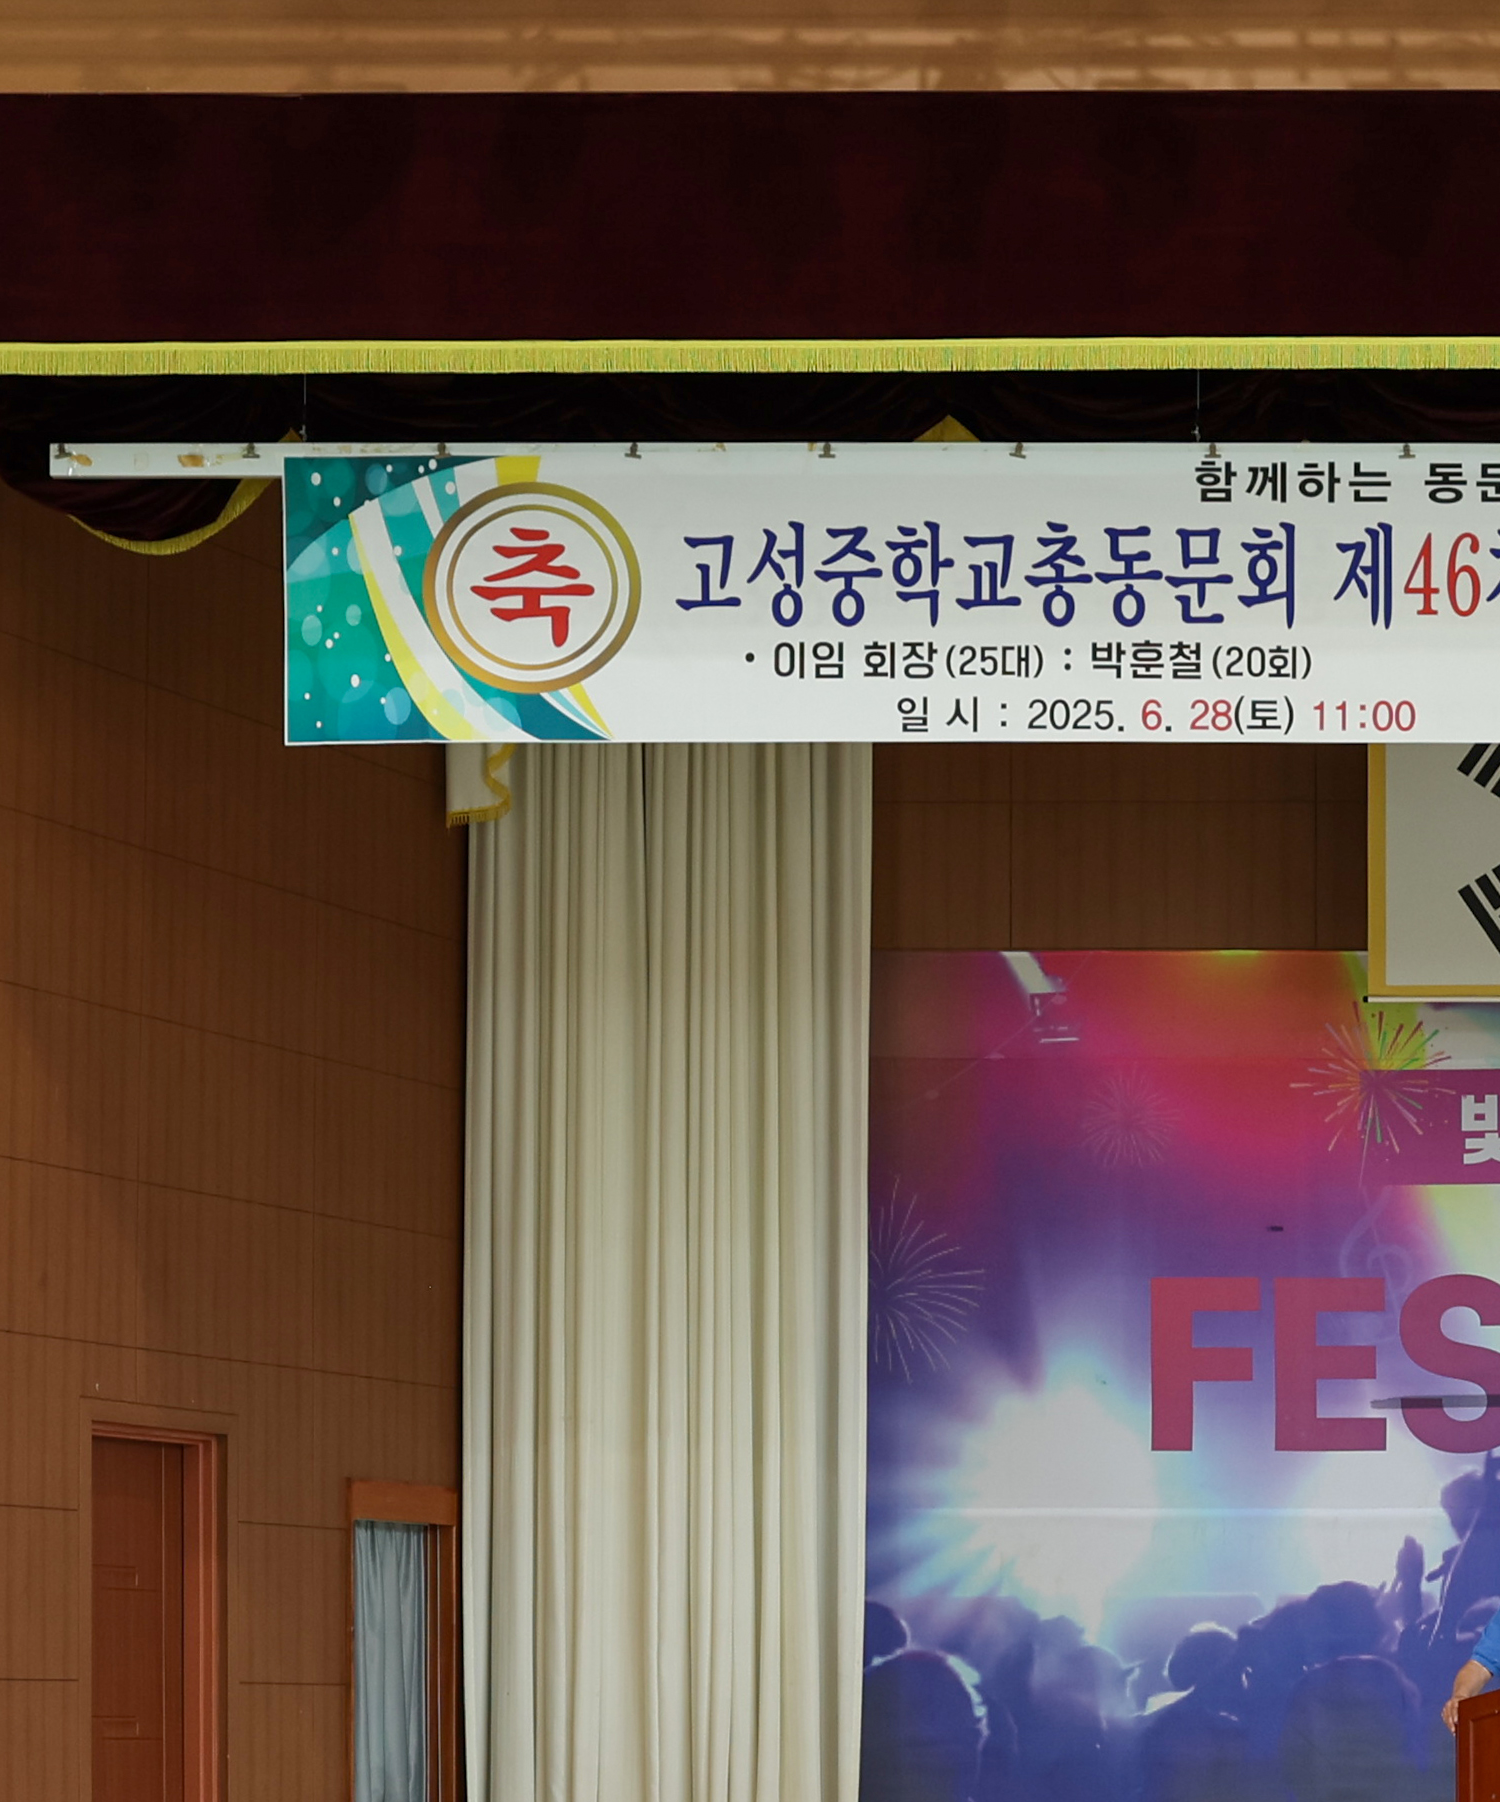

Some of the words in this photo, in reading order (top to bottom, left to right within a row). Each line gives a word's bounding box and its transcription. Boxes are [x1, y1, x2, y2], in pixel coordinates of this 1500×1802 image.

[1195, 459, 1392, 504] 함께하는
[473, 529, 592, 644] 축
[676, 521, 1295, 629] 고성중학교총동문회
[774, 642, 843, 679] 이임
[864, 641, 1043, 679] 회장(25대)
[1028, 699, 1124, 731] 2025.
[1142, 699, 1173, 732] 6.
[1190, 696, 1293, 735] 28(토)
[1314, 701, 1415, 731] 11:00
